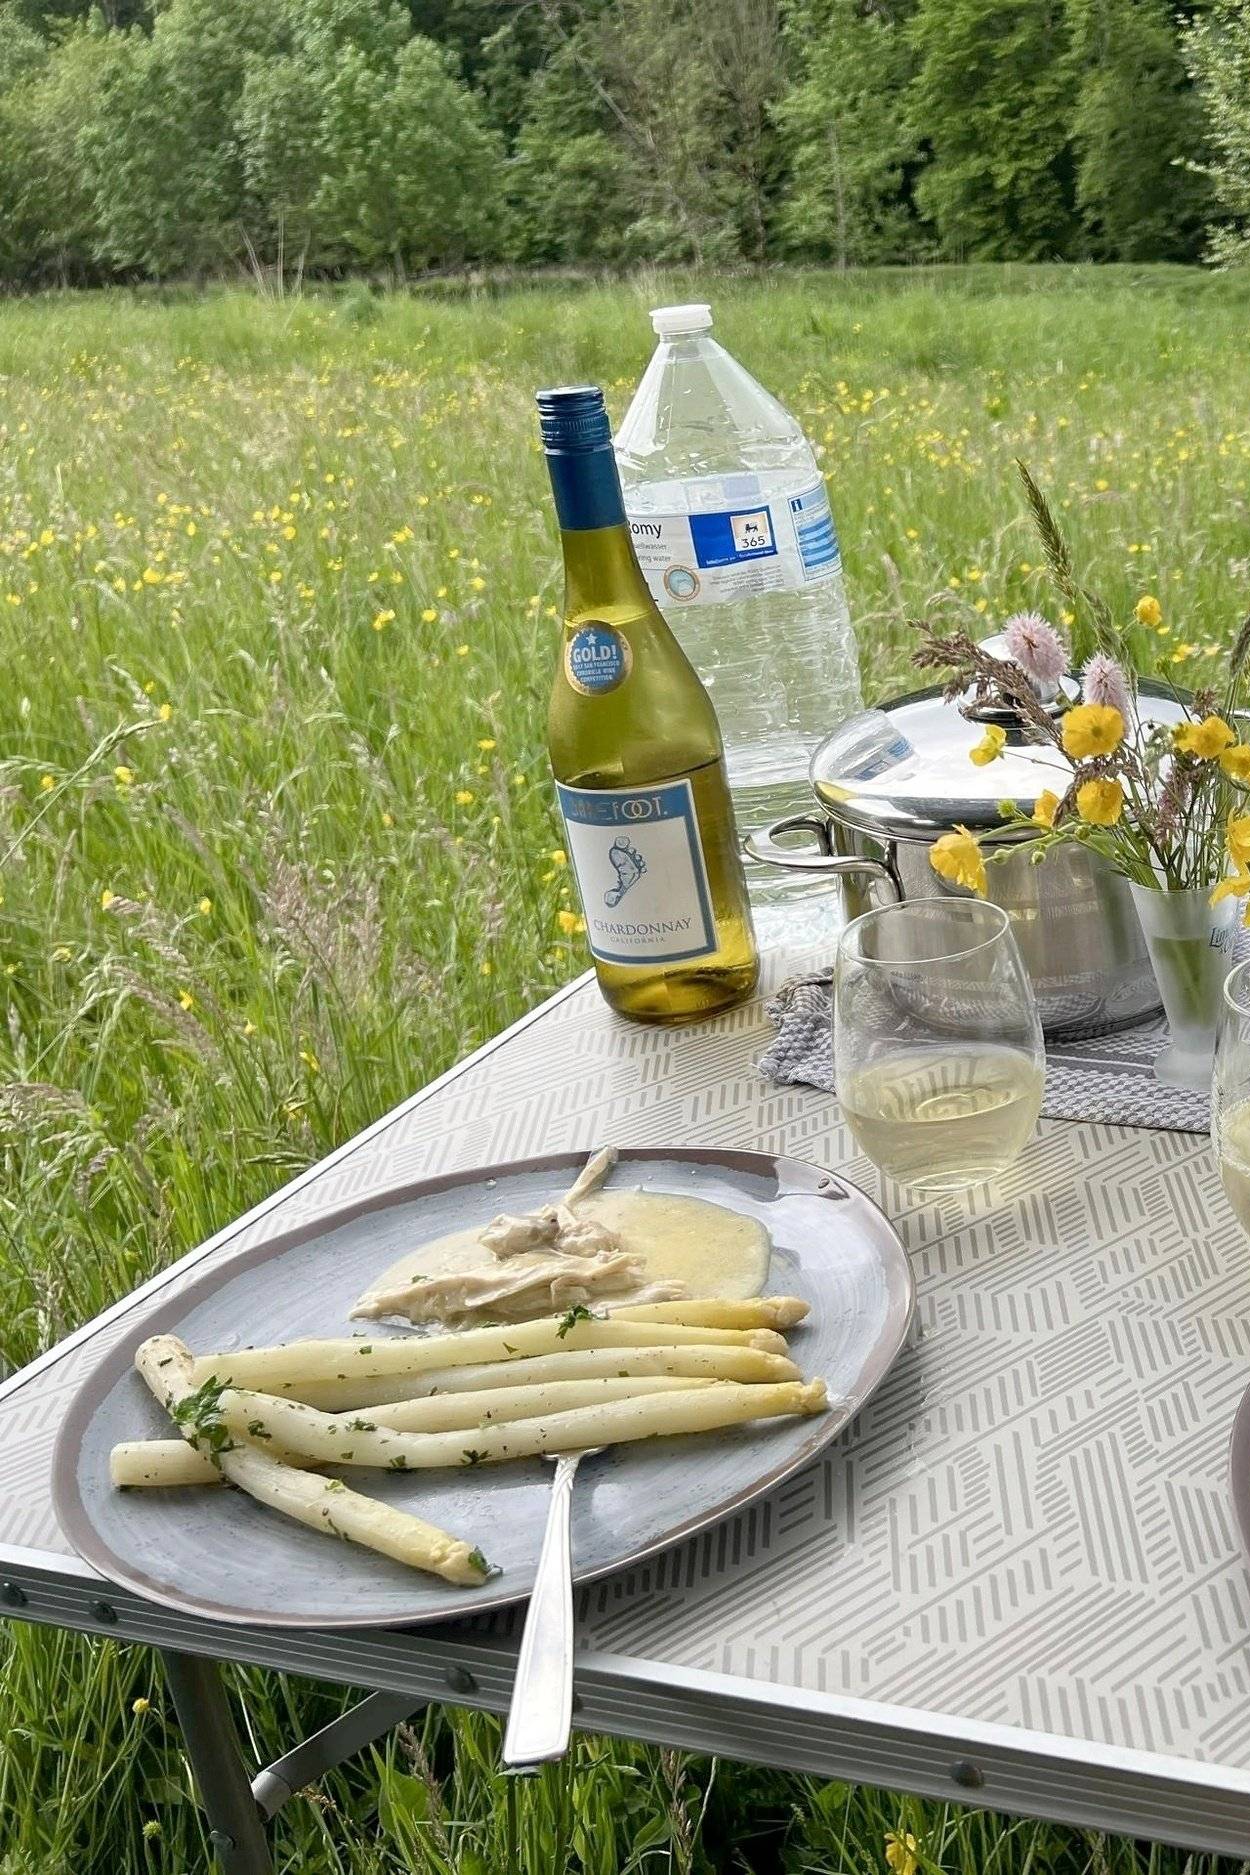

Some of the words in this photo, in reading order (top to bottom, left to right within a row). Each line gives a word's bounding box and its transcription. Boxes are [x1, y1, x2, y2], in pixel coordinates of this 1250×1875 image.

[630, 523, 662, 539] omy
[741, 535, 766, 549] 365
[573, 645, 617, 662] GOLD!
[593, 917, 692, 936] CHARDONNAY
